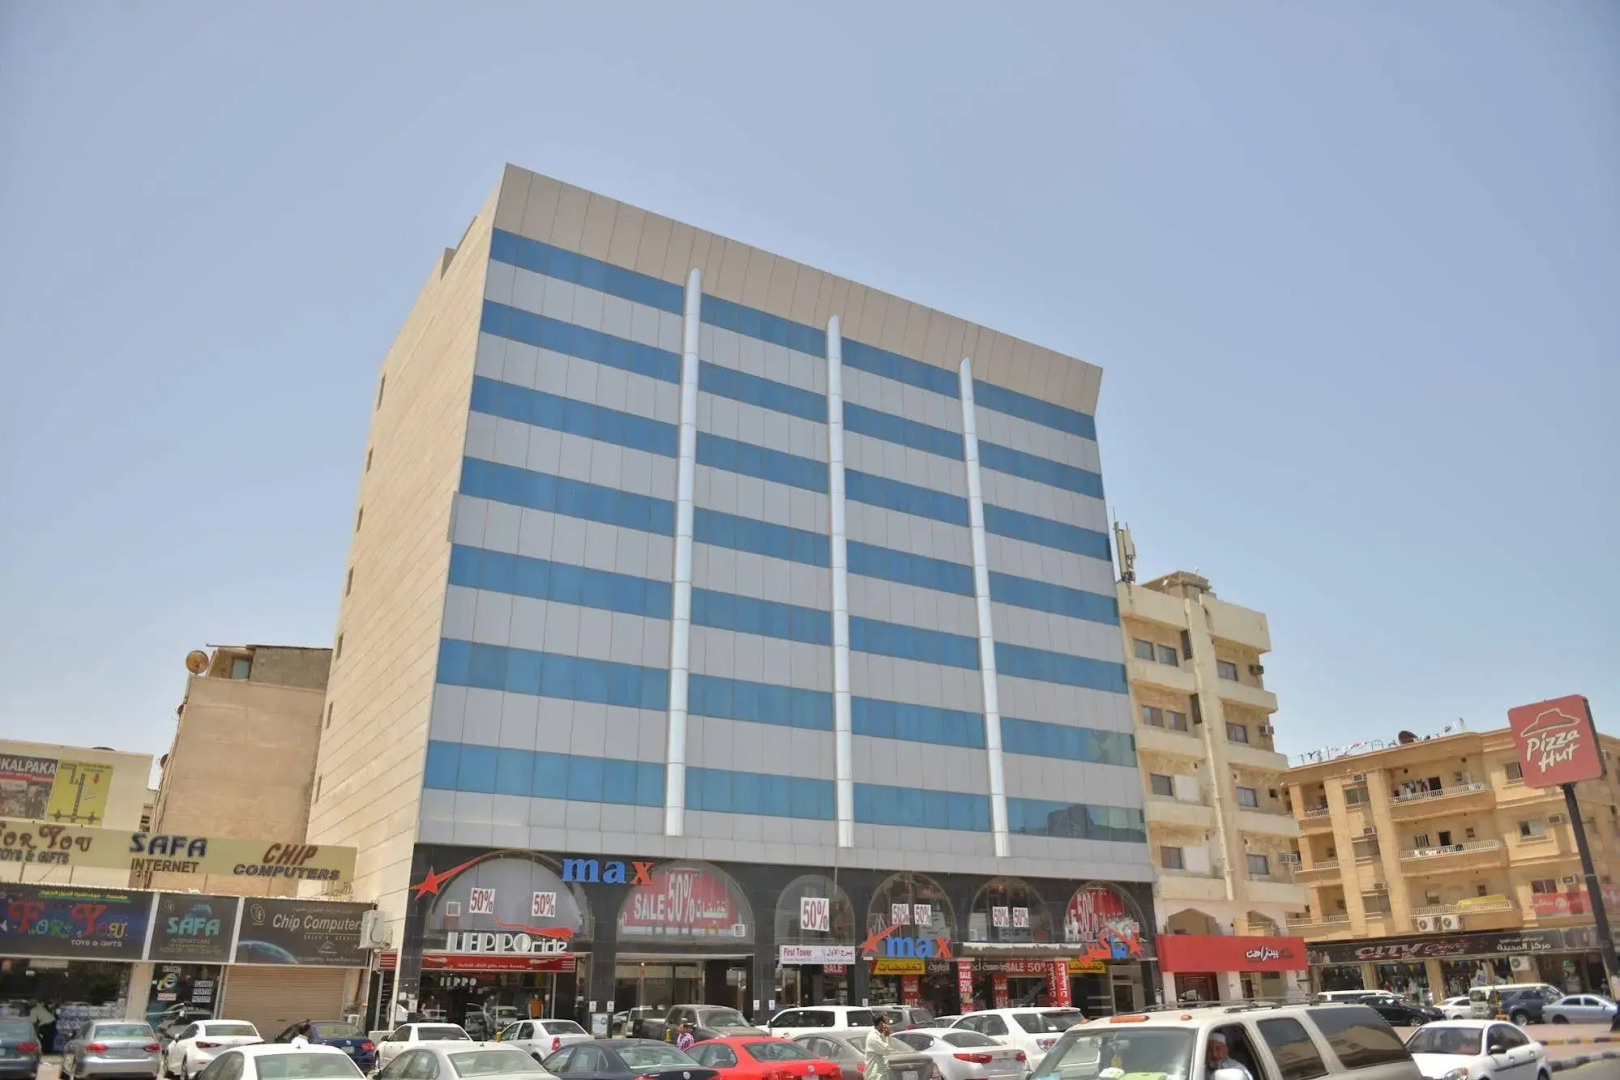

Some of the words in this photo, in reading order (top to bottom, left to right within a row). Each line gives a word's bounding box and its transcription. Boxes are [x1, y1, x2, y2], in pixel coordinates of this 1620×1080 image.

[1527, 730, 1580, 762] Pizza
[0, 758, 56, 774] KALPAKA
[1538, 743, 1579, 773] Hut
[129, 833, 208, 857] SAFA
[38, 851, 70, 865] GIFTS
[262, 843, 318, 866] CHIP
[131, 858, 199, 874] INTERNET
[233, 863, 340, 881] COMPUTERS
[562, 858, 654, 885] max
[470, 889, 494, 913] 50%
[533, 894, 556, 916] 50%
[634, 893, 665, 921] SALE
[668, 873, 695, 923] 50%
[272, 913, 300, 931] Chip
[803, 901, 828, 929] 50%
[916, 904, 932, 924] 50%
[993, 908, 1009, 926] 50%
[1014, 908, 1030, 927] 50%
[166, 916, 220, 937] SAFA
[783, 948, 795, 957] First
[796, 948, 812, 957] Tower
[885, 936, 952, 958] max
[1496, 942, 1528, 952] المدينة
[1531, 941, 1551, 951] مركز
[823, 963, 844, 973] SALE
[878, 962, 922, 974] تخفيضات
[1006, 963, 1025, 972] SALE
[960, 980, 973, 993] 50%
